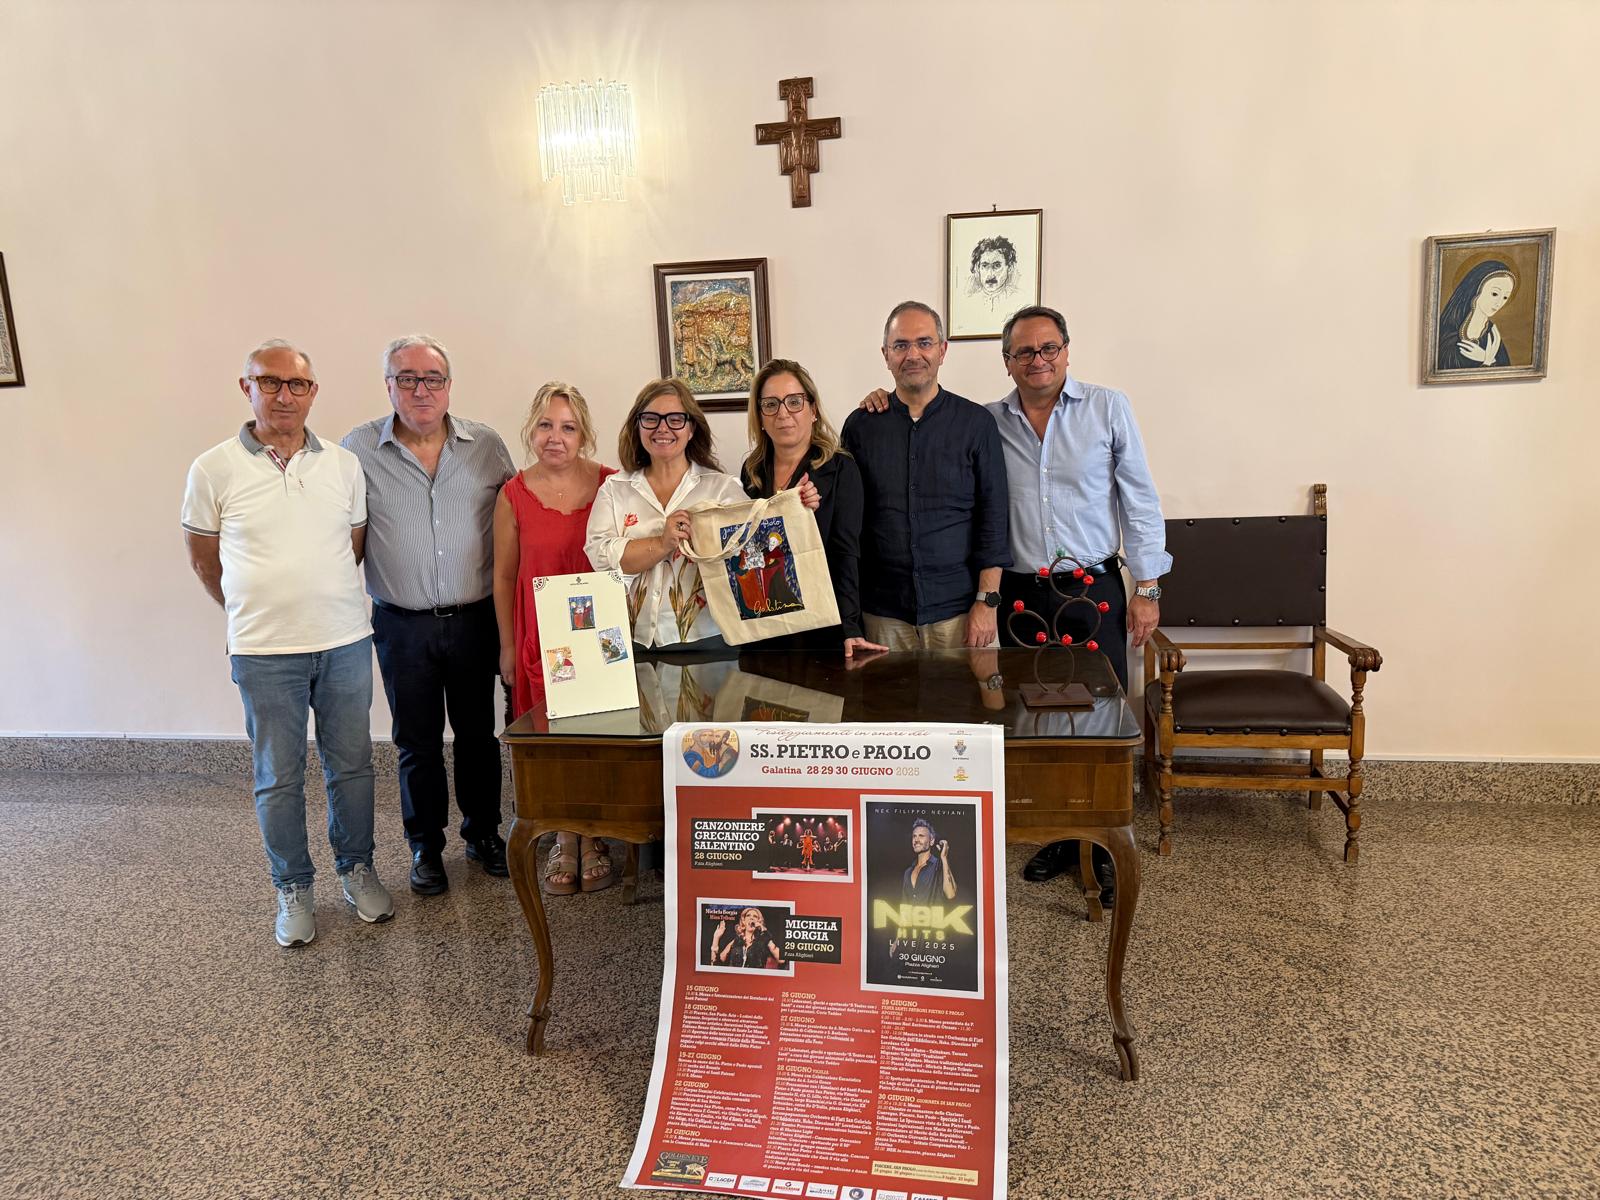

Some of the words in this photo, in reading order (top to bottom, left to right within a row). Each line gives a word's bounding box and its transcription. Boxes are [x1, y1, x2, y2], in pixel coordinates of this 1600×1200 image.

[750, 744, 774, 759] SS.
[776, 744, 850, 759] PIETRO
[851, 749, 860, 759] e
[863, 745, 931, 760] PAOLO
[762, 766, 802, 774] Galatina
[807, 766, 819, 775] 28
[821, 766, 834, 775] 29
[835, 766, 848, 775] 30
[851, 767, 894, 776] GIUGNO
[896, 767, 920, 776] 2025
[694, 821, 765, 832] CANZONIERE
[694, 831, 760, 841] GRECANICO
[694, 841, 755, 851] SALENTINO
[694, 852, 705, 860] 28
[706, 852, 742, 861] GIUGNO
[784, 919, 838, 932] MICHELA
[784, 929, 829, 941] BORGIA
[897, 927, 946, 940] HITS
[784, 942, 796, 950] 29
[796, 942, 834, 952] GIUGNO
[889, 940, 917, 948] LIVE
[925, 941, 955, 951] 2025
[898, 953, 910, 961] 30
[911, 954, 946, 964] GIUGNO
[693, 985, 719, 993] GIUGNO
[790, 992, 817, 1000] GIUGNO
[890, 999, 918, 1008] GIUGNO
[789, 1016, 815, 1024] GIUGNO
[785, 1065, 812, 1073] GIUGNO
[887, 1094, 915, 1103] GIUGNO
[673, 1129, 701, 1137] GIUGNO
